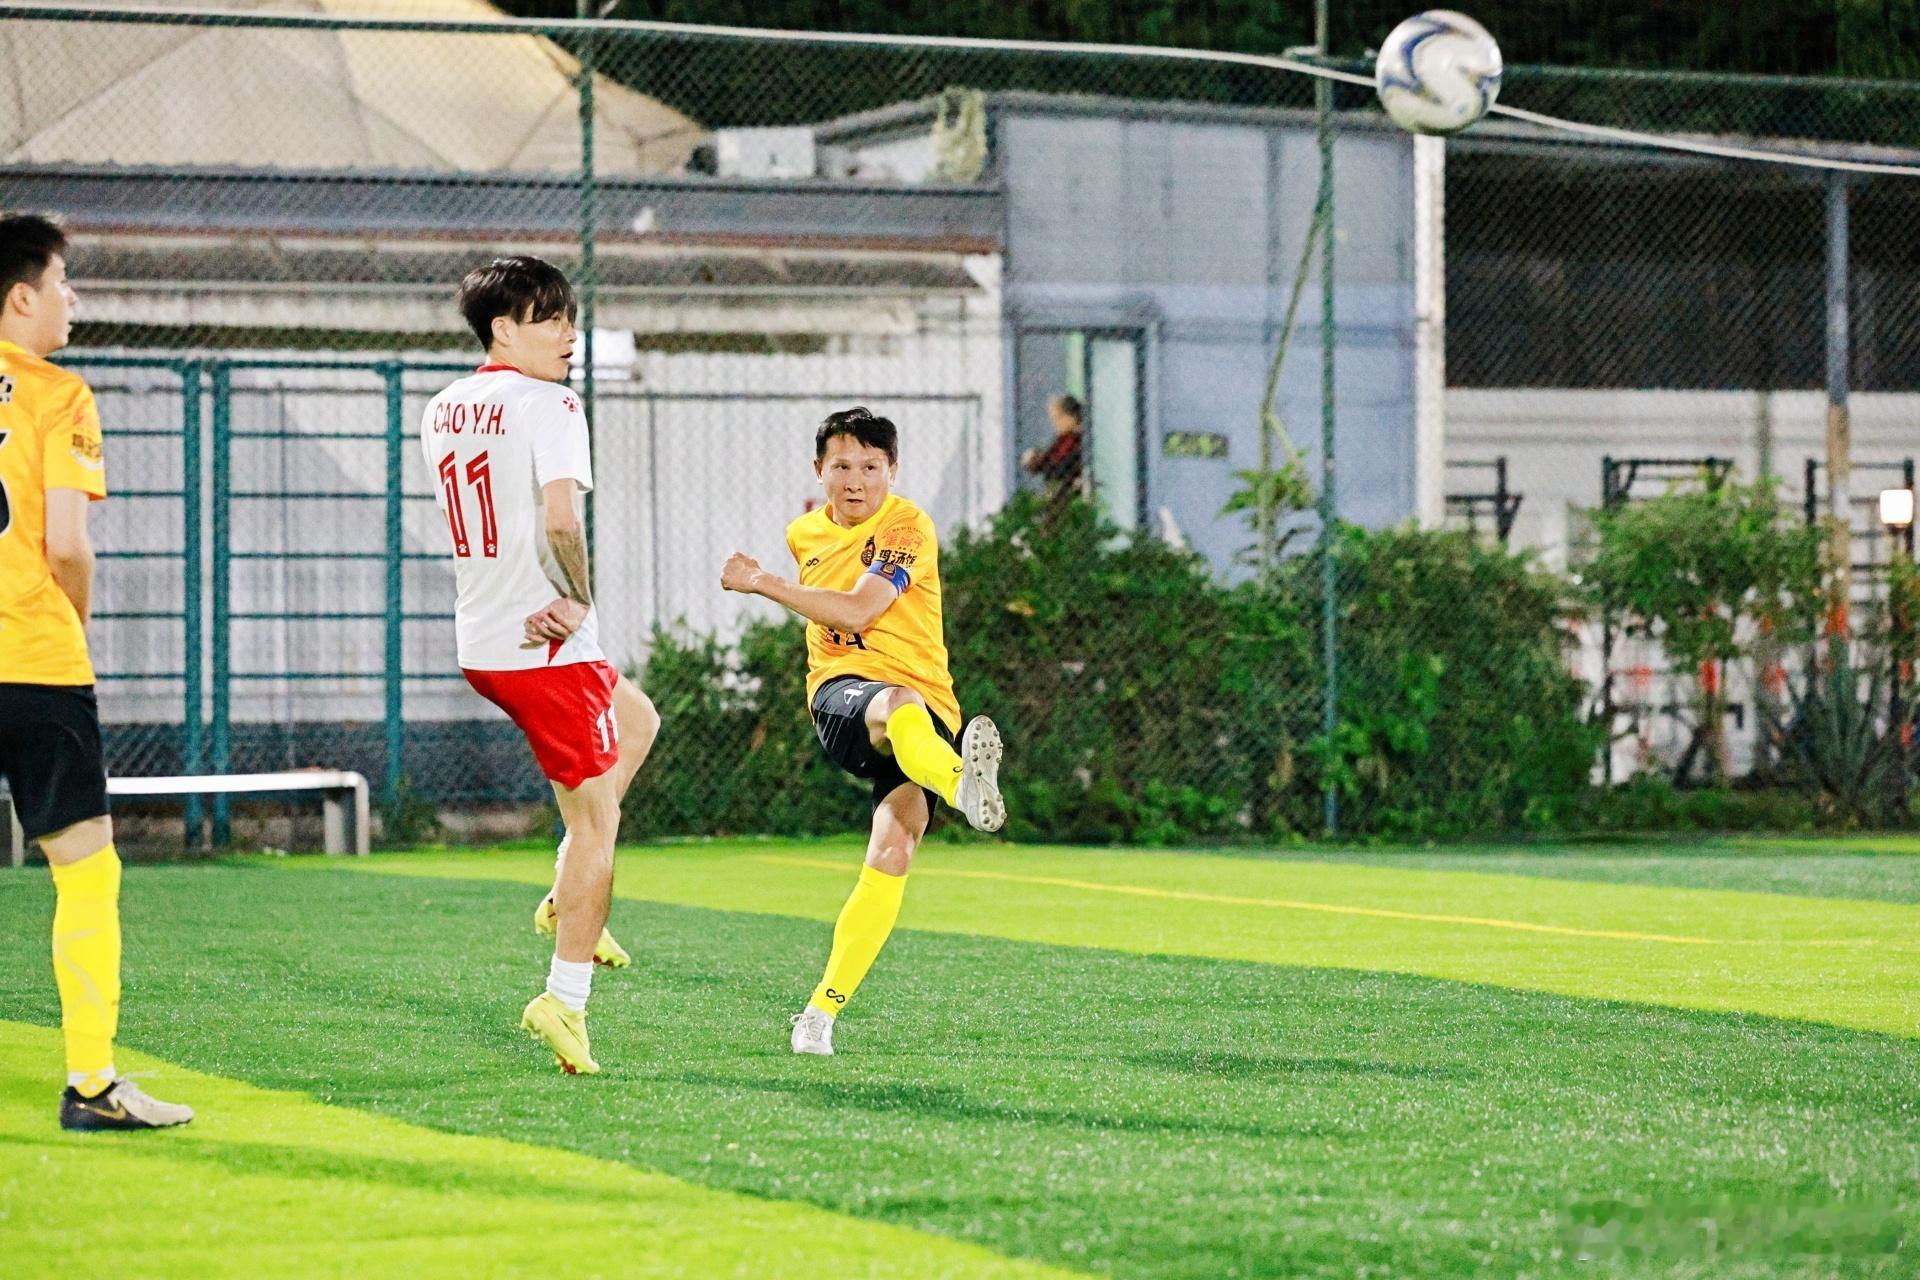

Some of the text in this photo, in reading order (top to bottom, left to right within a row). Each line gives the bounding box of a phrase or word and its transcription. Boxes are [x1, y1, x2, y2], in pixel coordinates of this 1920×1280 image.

[434, 402, 505, 435] CAO Y.H.
[438, 450, 498, 558] 11
